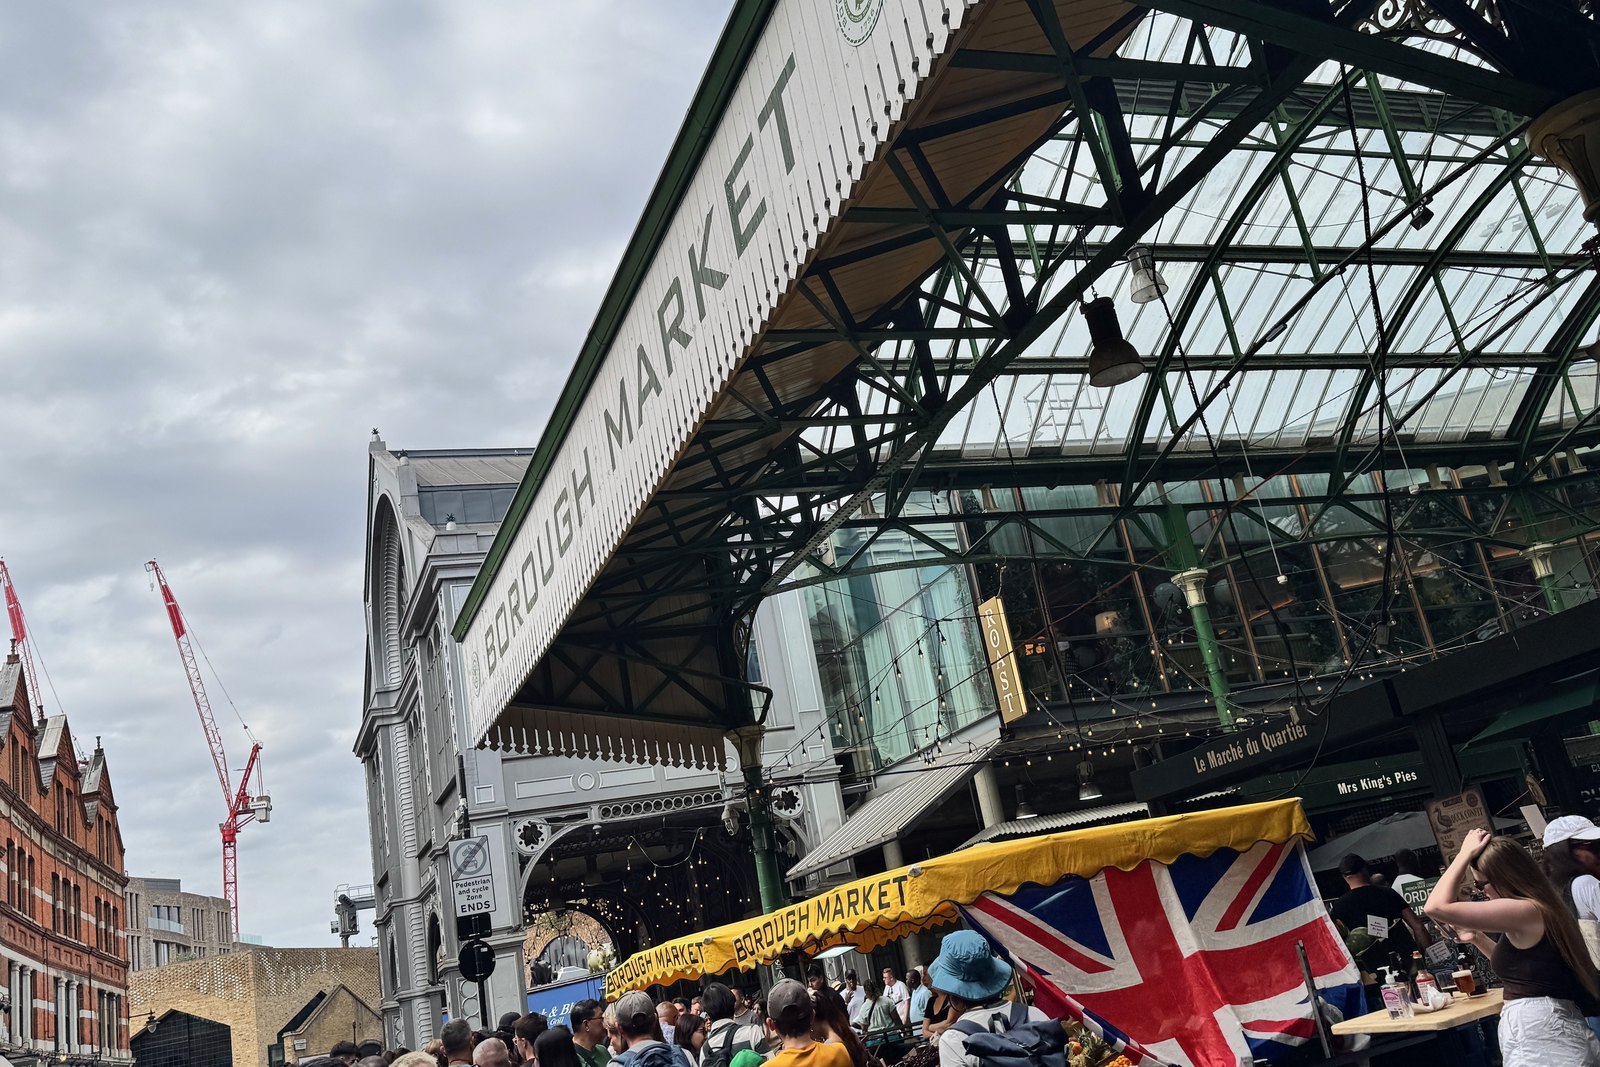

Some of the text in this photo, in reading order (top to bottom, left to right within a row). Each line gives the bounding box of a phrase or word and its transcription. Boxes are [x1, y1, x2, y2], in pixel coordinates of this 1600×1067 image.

[485, 51, 796, 678] BOROUGH MARKET
[984, 608, 1014, 713] ROAST
[1193, 724, 1308, 774] Le Marché du Quartier
[1337, 770, 1417, 795] Mrs King's Pies
[455, 878, 490, 889] Pedestrian
[458, 885, 489, 895] and cycle
[461, 900, 490, 913] ENDS
[732, 875, 909, 963] BOROUGH MARKET
[605, 942, 703, 994] BOROUGH MARKET
